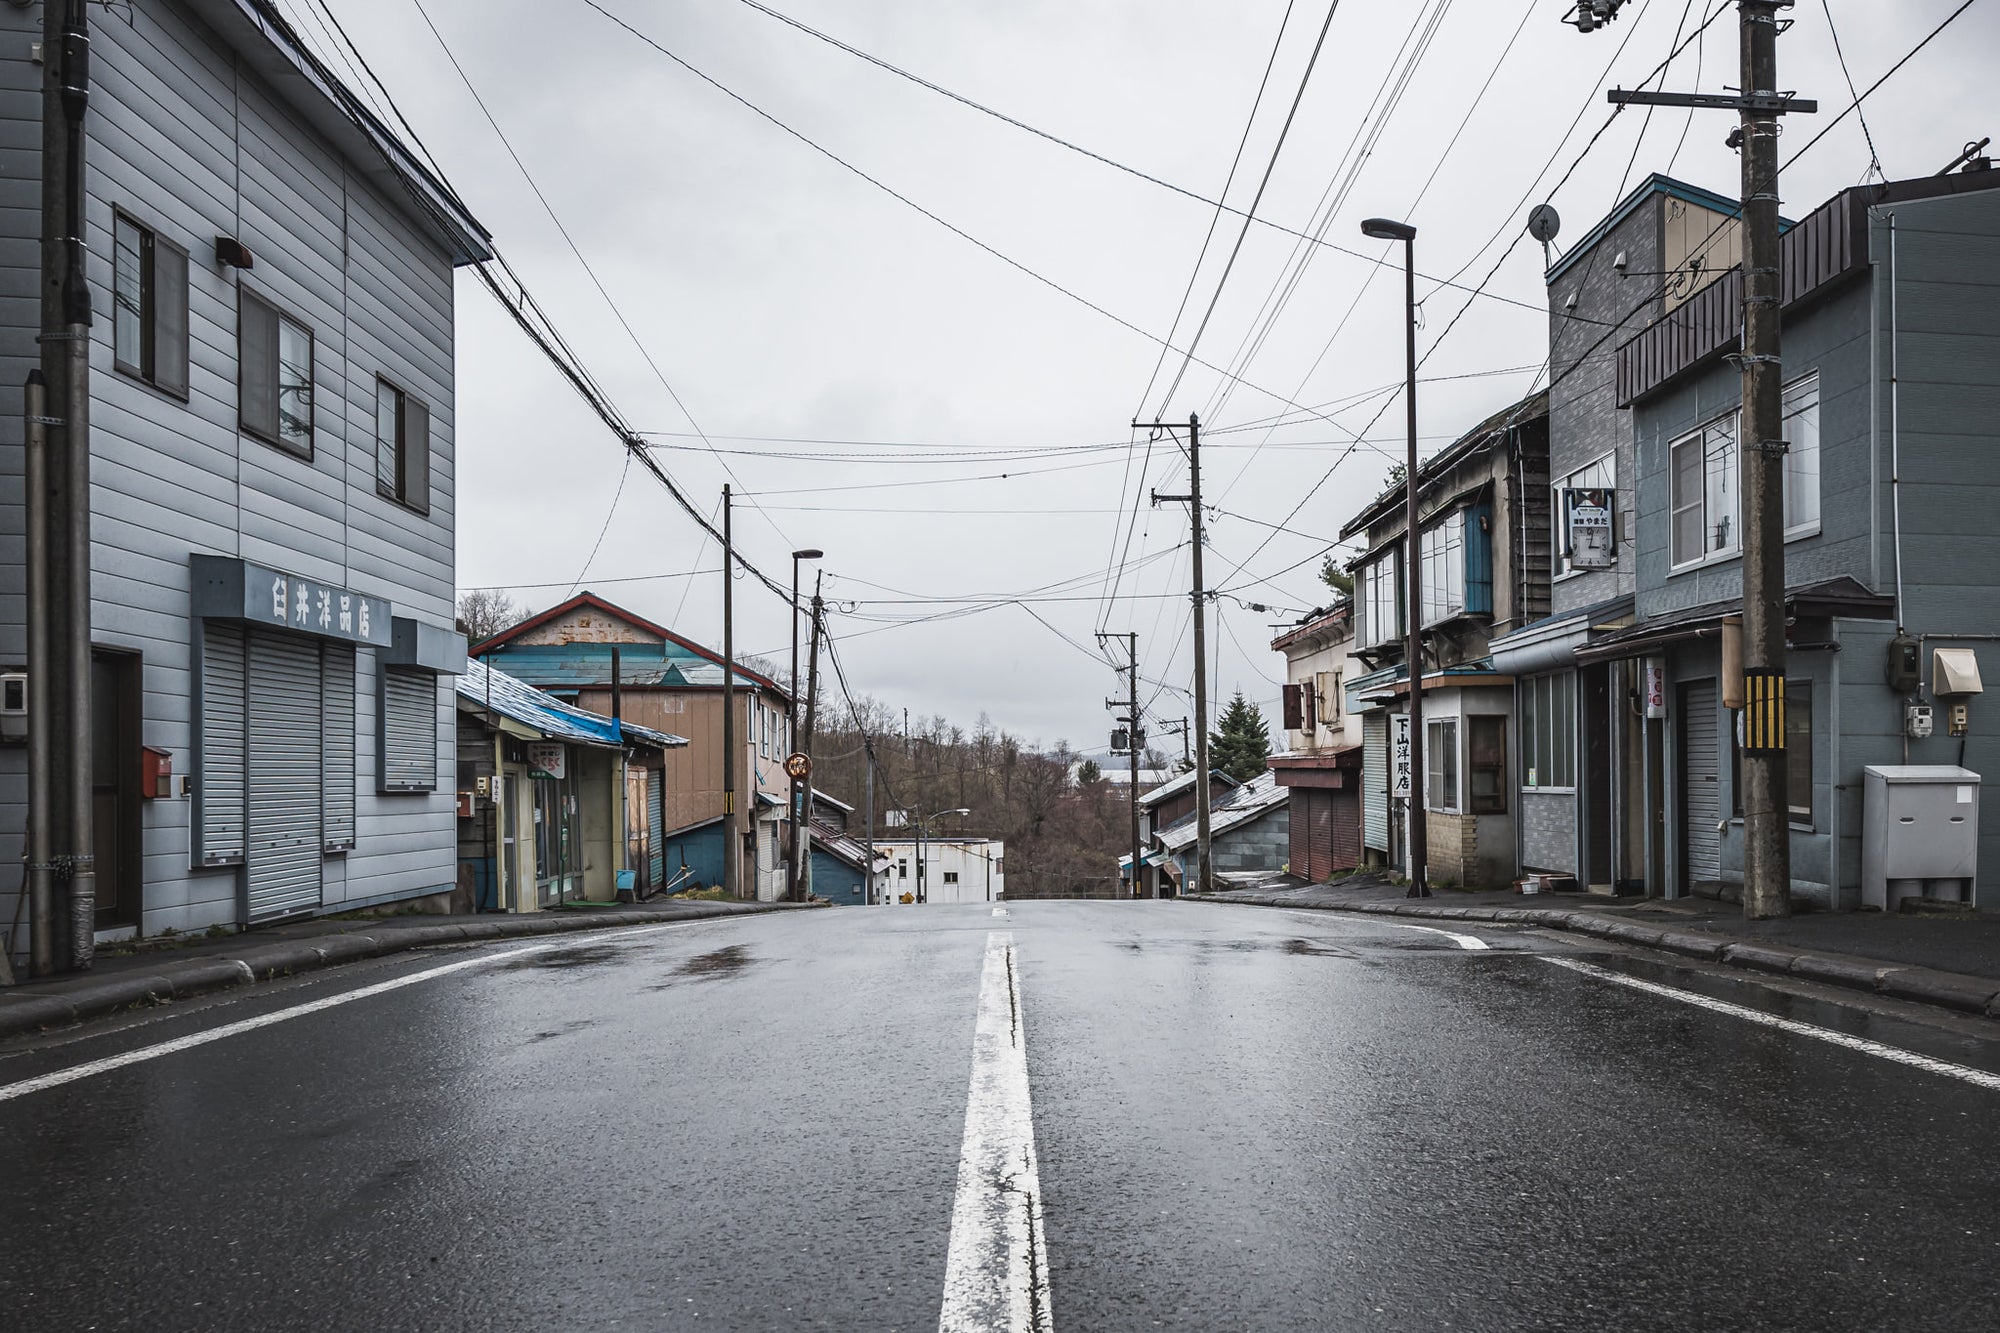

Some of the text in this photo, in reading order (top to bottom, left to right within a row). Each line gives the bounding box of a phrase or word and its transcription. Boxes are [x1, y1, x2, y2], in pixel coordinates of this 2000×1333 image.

[272, 577, 370, 638] 臼井洋品店
[1396, 718, 1411, 790] 下山洋服店
